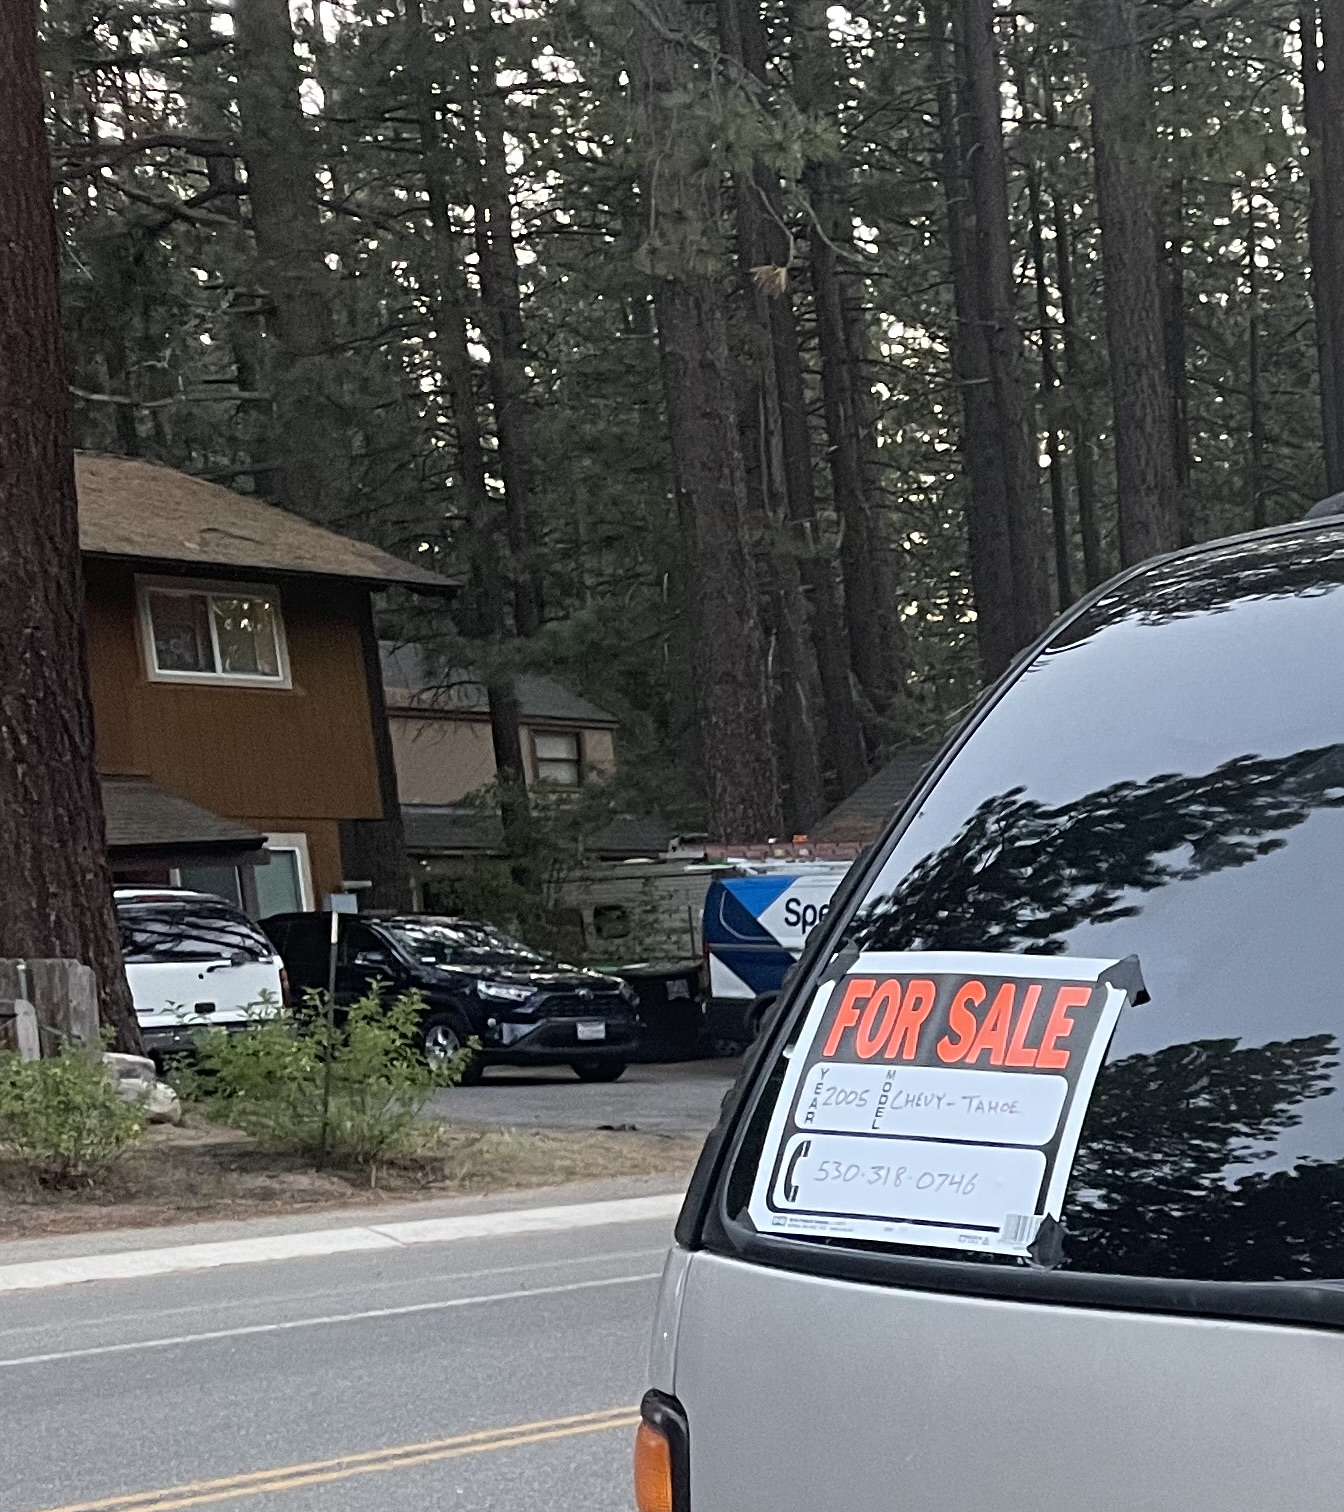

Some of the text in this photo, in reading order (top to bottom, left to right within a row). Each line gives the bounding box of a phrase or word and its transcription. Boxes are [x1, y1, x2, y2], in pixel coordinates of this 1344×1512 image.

[823, 978, 1093, 1069] FOR SALE
[804, 1067, 829, 1124] YEAR
[822, 1086, 871, 1108] 2005
[871, 1069, 897, 1130] MODEL
